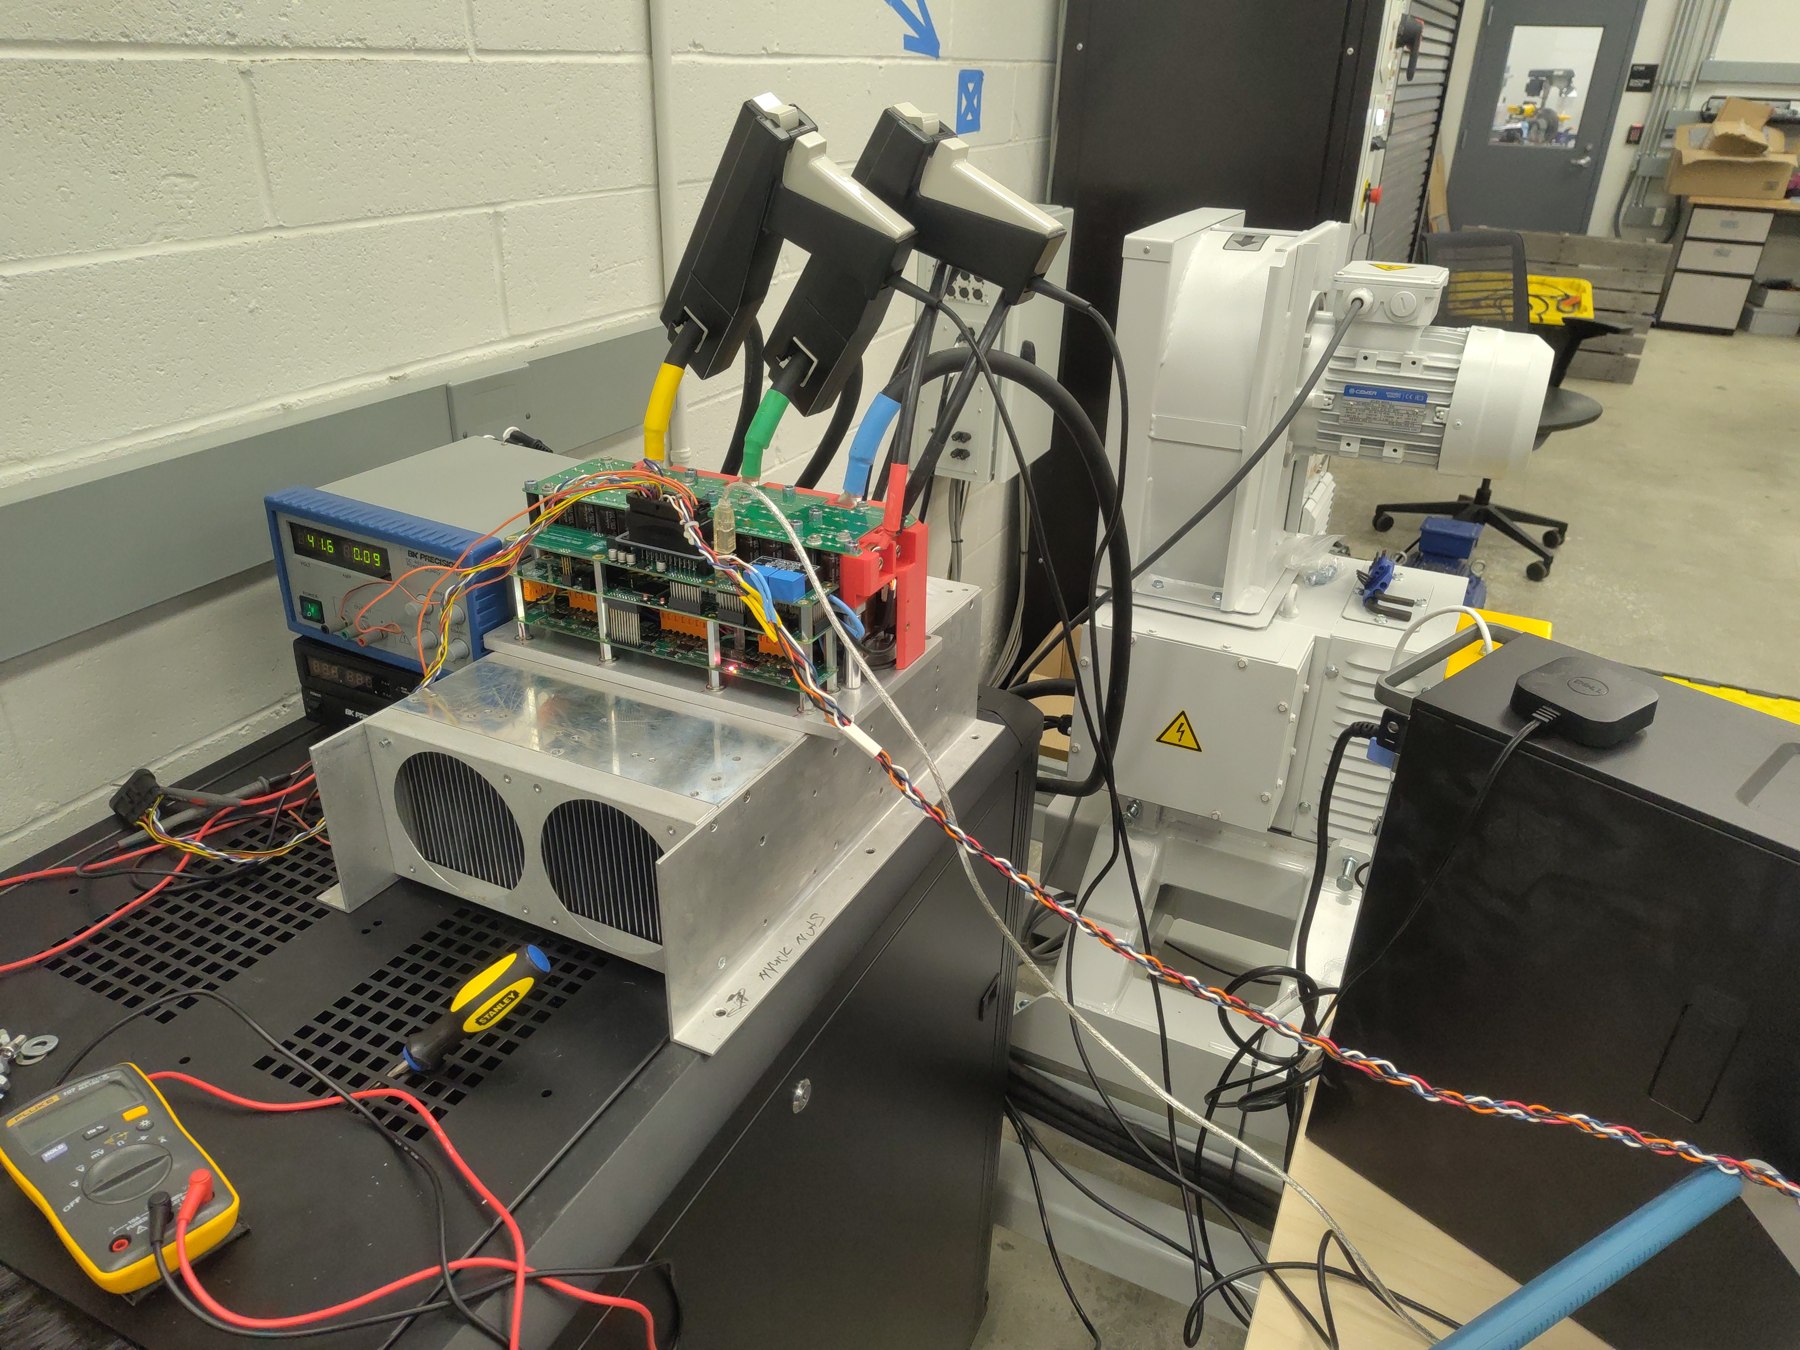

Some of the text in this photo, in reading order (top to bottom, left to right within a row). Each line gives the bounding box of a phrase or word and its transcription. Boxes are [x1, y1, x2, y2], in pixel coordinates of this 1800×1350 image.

[306, 533, 382, 567] 41.6 0.09
[408, 550, 419, 559] BK
[478, 992, 516, 1024] STANLEY
[14, 1098, 55, 1122] FLUKE
[62, 1196, 82, 1212] OFF
